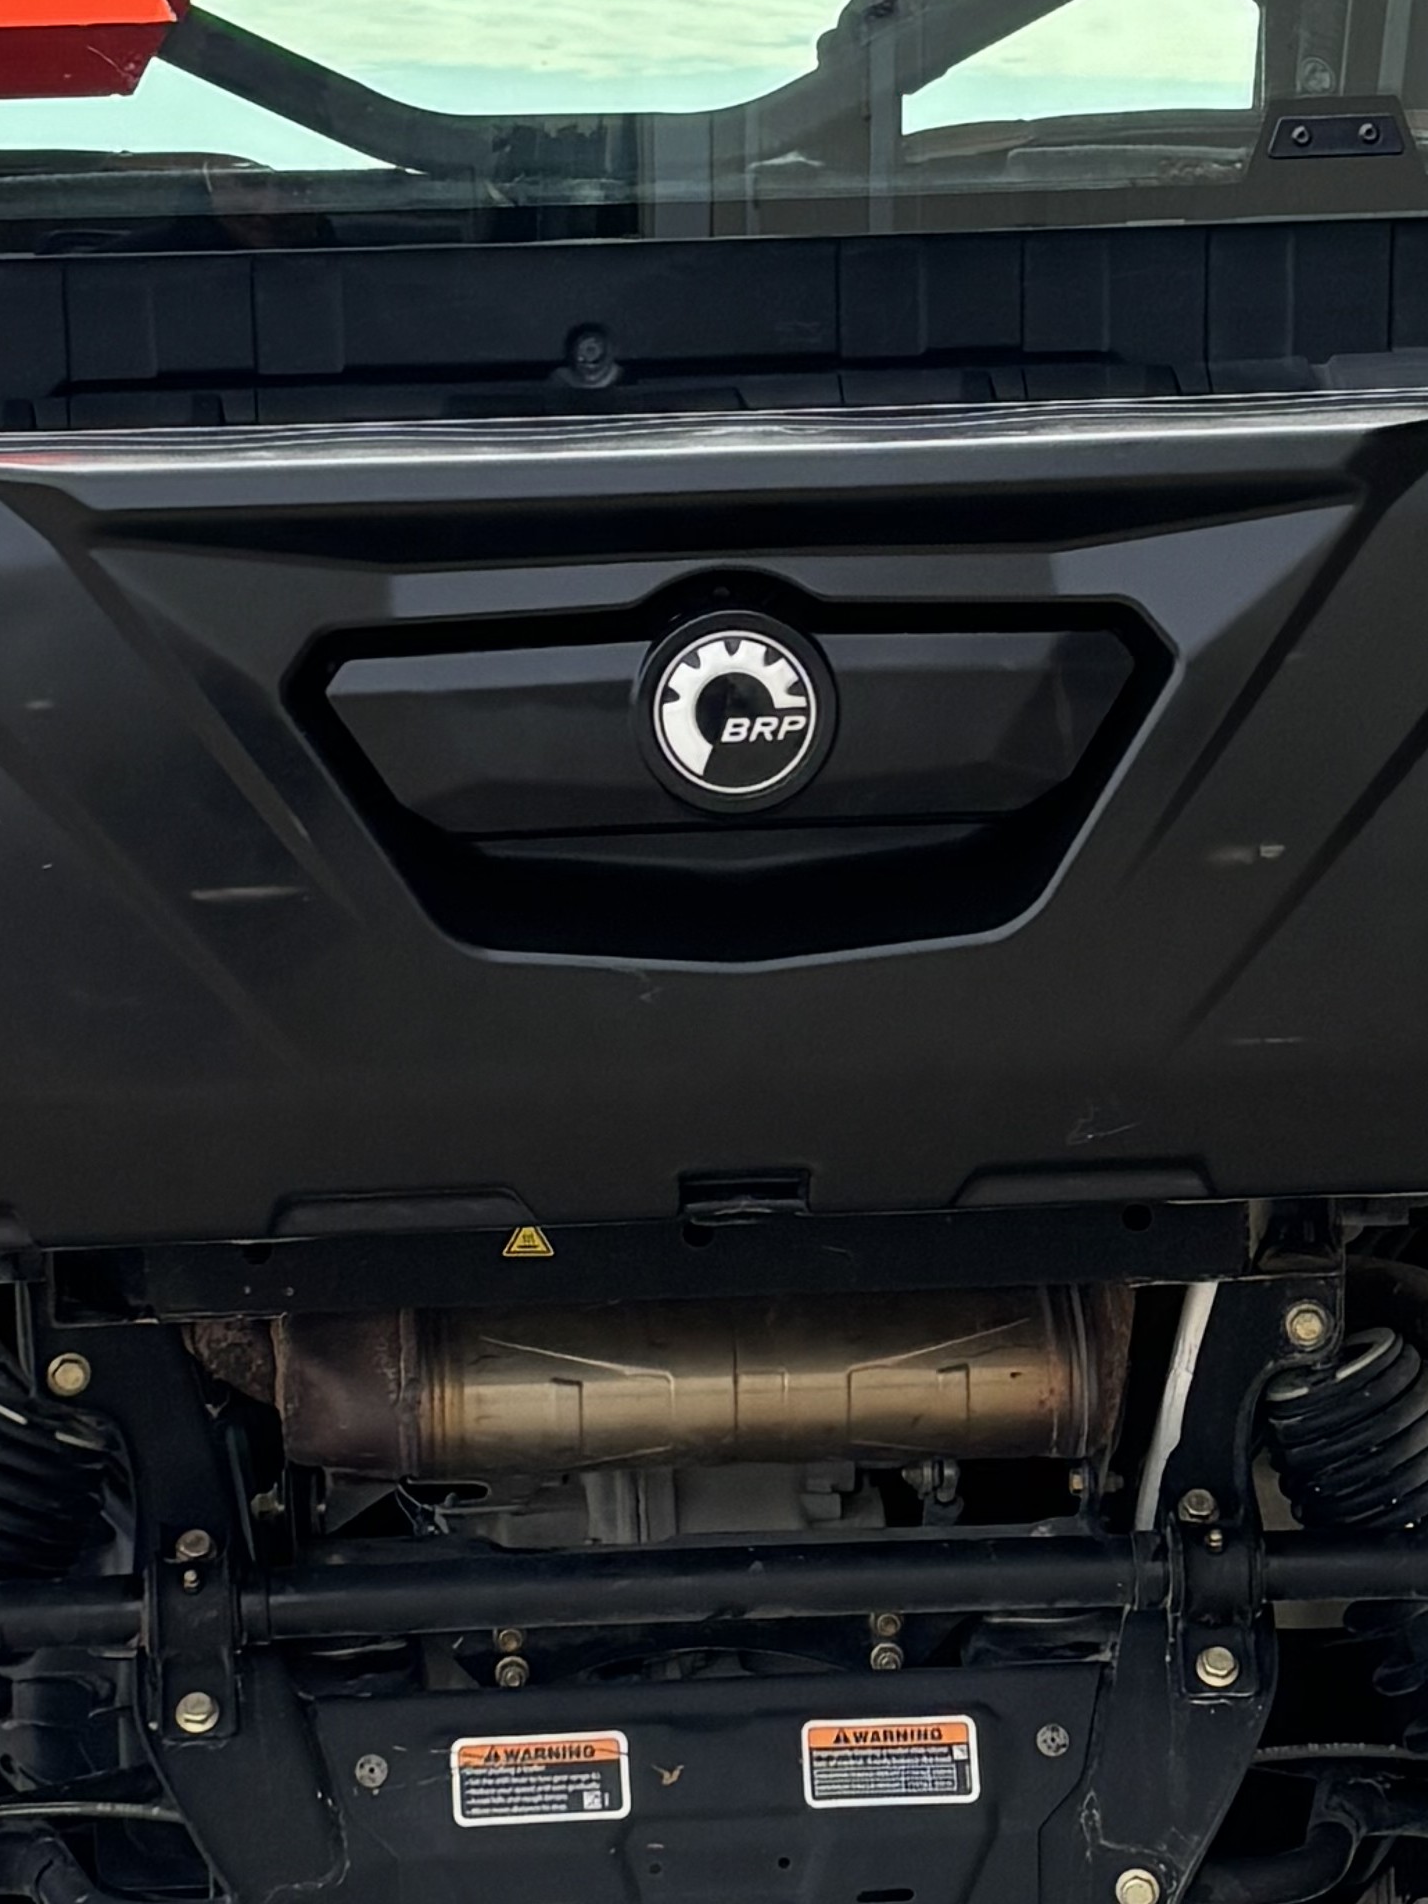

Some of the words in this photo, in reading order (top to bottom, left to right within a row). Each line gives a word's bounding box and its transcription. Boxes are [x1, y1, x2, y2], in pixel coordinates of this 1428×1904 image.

[720, 715, 807, 743] BRP
[853, 1727, 943, 1744] WARNING
[503, 1744, 596, 1763] WARNING
